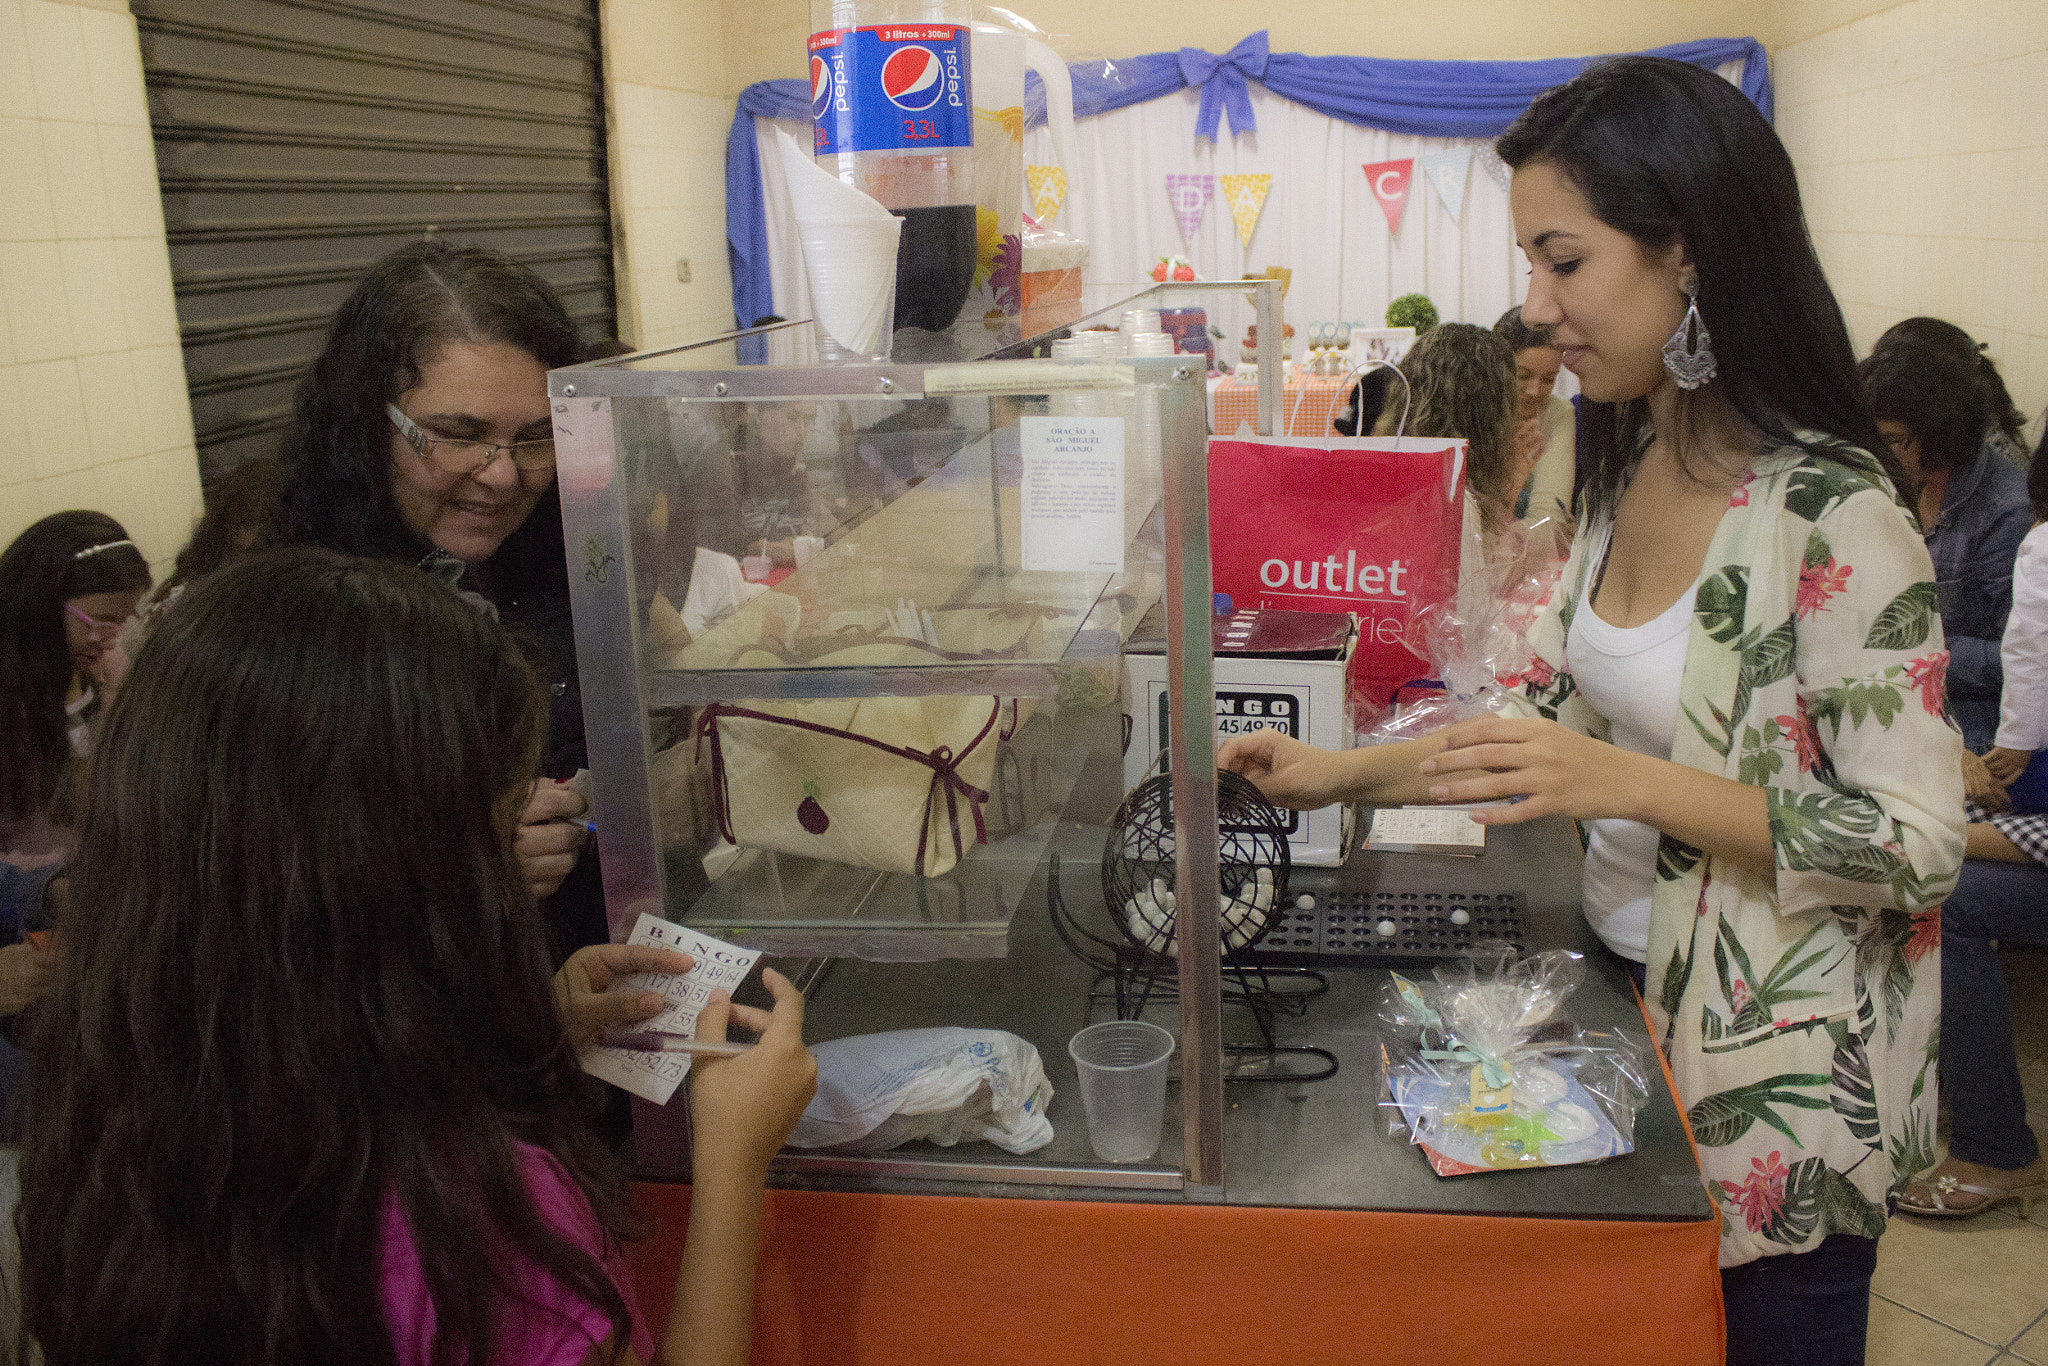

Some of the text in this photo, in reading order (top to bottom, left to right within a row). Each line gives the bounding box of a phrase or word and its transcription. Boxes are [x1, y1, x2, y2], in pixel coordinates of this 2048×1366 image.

[885, 31, 891, 39] 3
[892, 30, 919, 39] litros
[831, 51, 850, 112] pepsi
[944, 48, 963, 107] pepsi
[903, 120, 940, 141] 3,3L
[1037, 177, 1059, 206] A
[1376, 171, 1401, 200] C
[1046, 435, 1101, 444] SÃO MIGUEL
[1050, 427, 1087, 436] ORAÇÃO
[1260, 550, 1407, 596] outlet
[1215, 699, 1290, 716] NGO
[1218, 719, 1240, 734] 45
[707, 966, 724, 981] 49
[671, 981, 691, 999] 38
[677, 1012, 695, 1028] 55
[663, 1062, 682, 1079] 73
